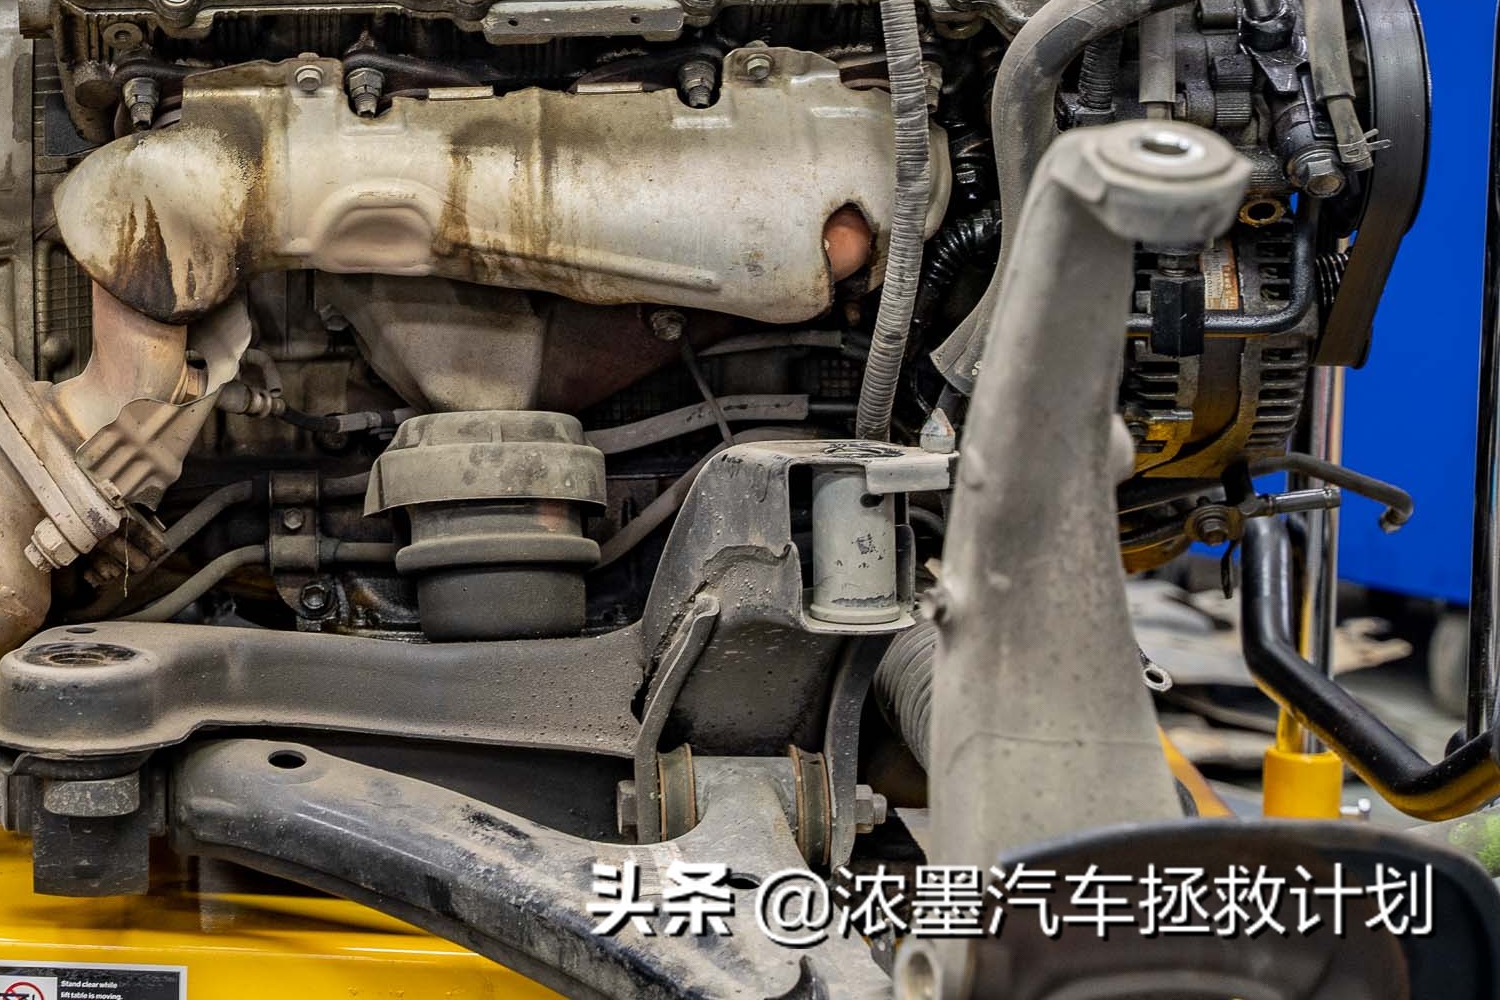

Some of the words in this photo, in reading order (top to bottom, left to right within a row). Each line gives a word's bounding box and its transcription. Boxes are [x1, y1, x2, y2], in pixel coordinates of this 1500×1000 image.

[60, 980, 82, 988] Stand
[60, 991, 70, 999] lift
[70, 991, 88, 999] table
